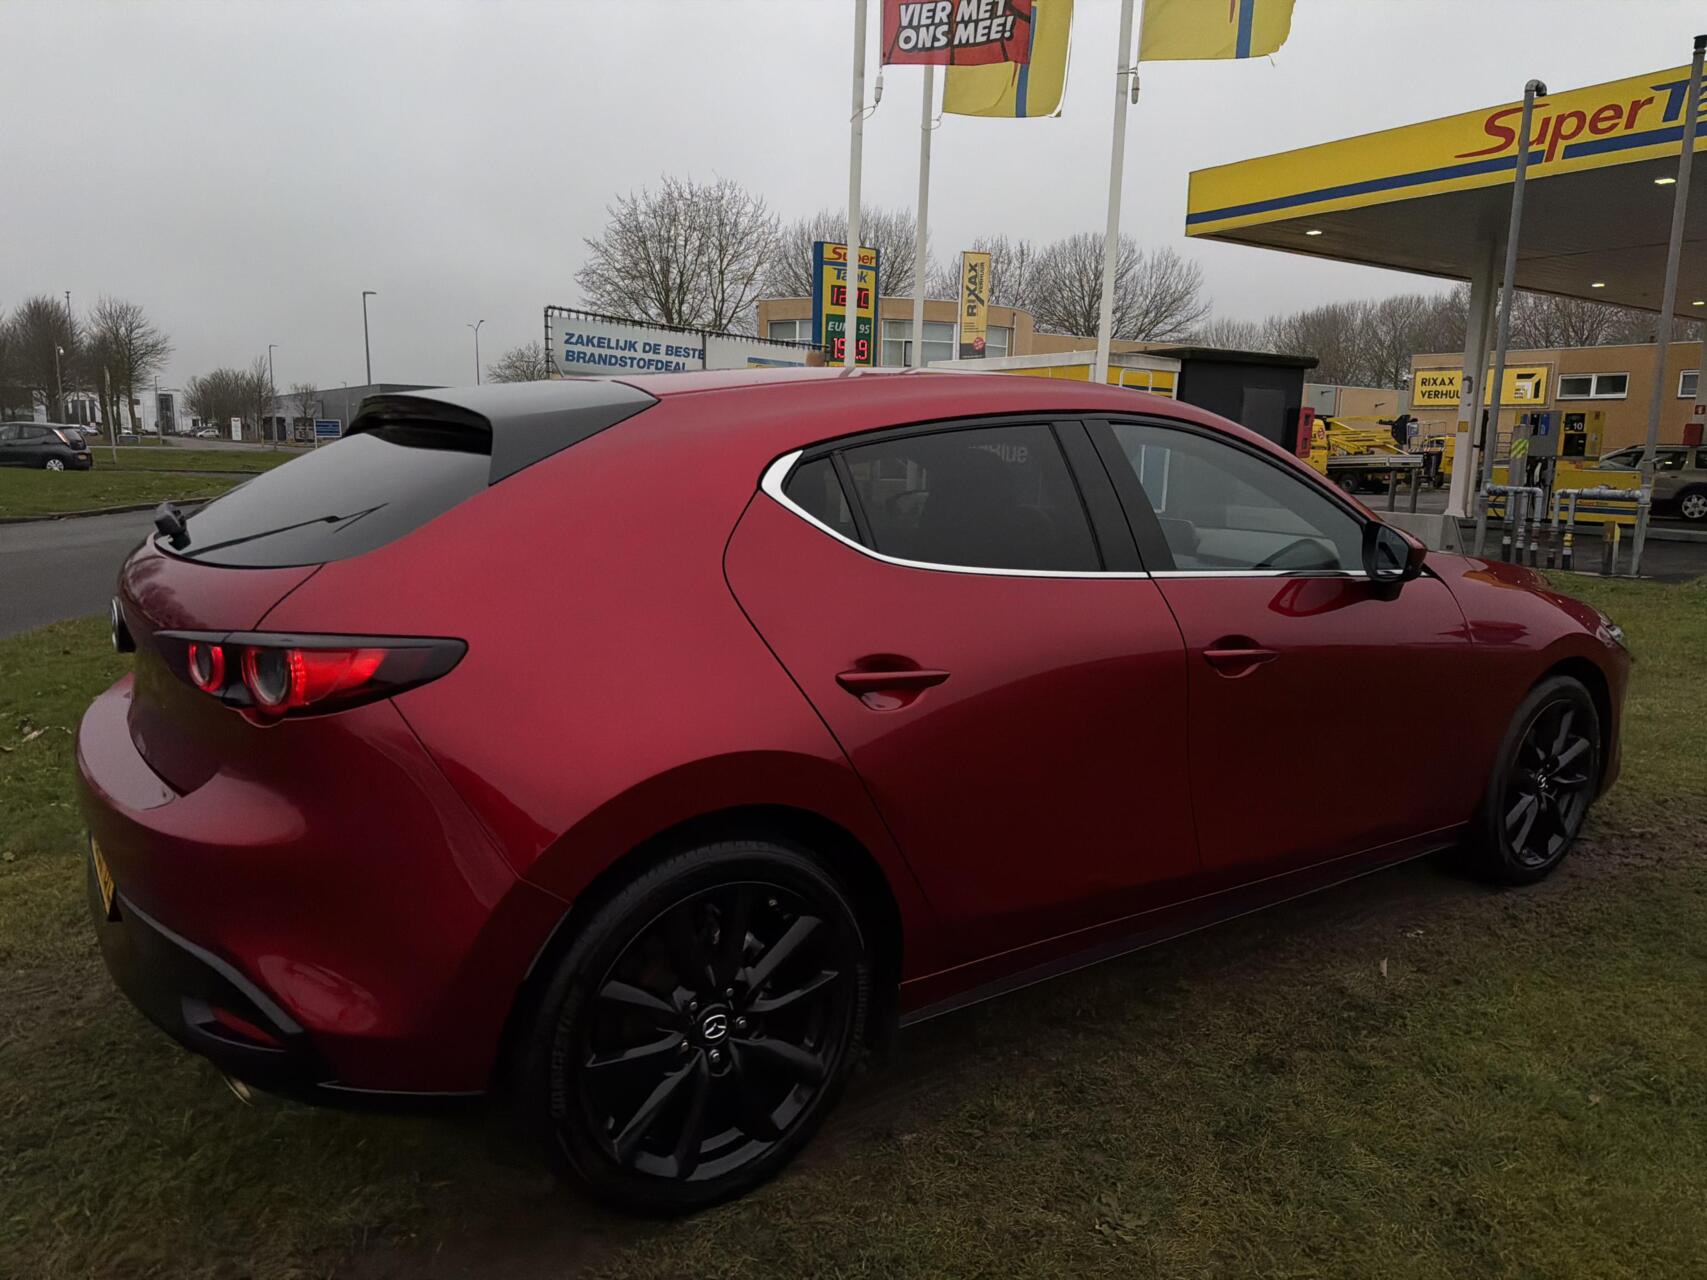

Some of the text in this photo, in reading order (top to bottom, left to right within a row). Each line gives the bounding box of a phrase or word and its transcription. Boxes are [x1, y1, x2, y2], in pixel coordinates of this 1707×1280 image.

[900, 0, 1006, 26] VIER MET
[899, 15, 1015, 50] ONS MEE!
[1454, 75, 1707, 163] Super T
[832, 268, 869, 284] Tak
[966, 262, 985, 317] RIXAX
[859, 324, 871, 335] 95
[564, 332, 705, 360] ZAKELIJK DE BESTE
[1421, 377, 1455, 387] RIXAX
[1572, 422, 1583, 431] 10
